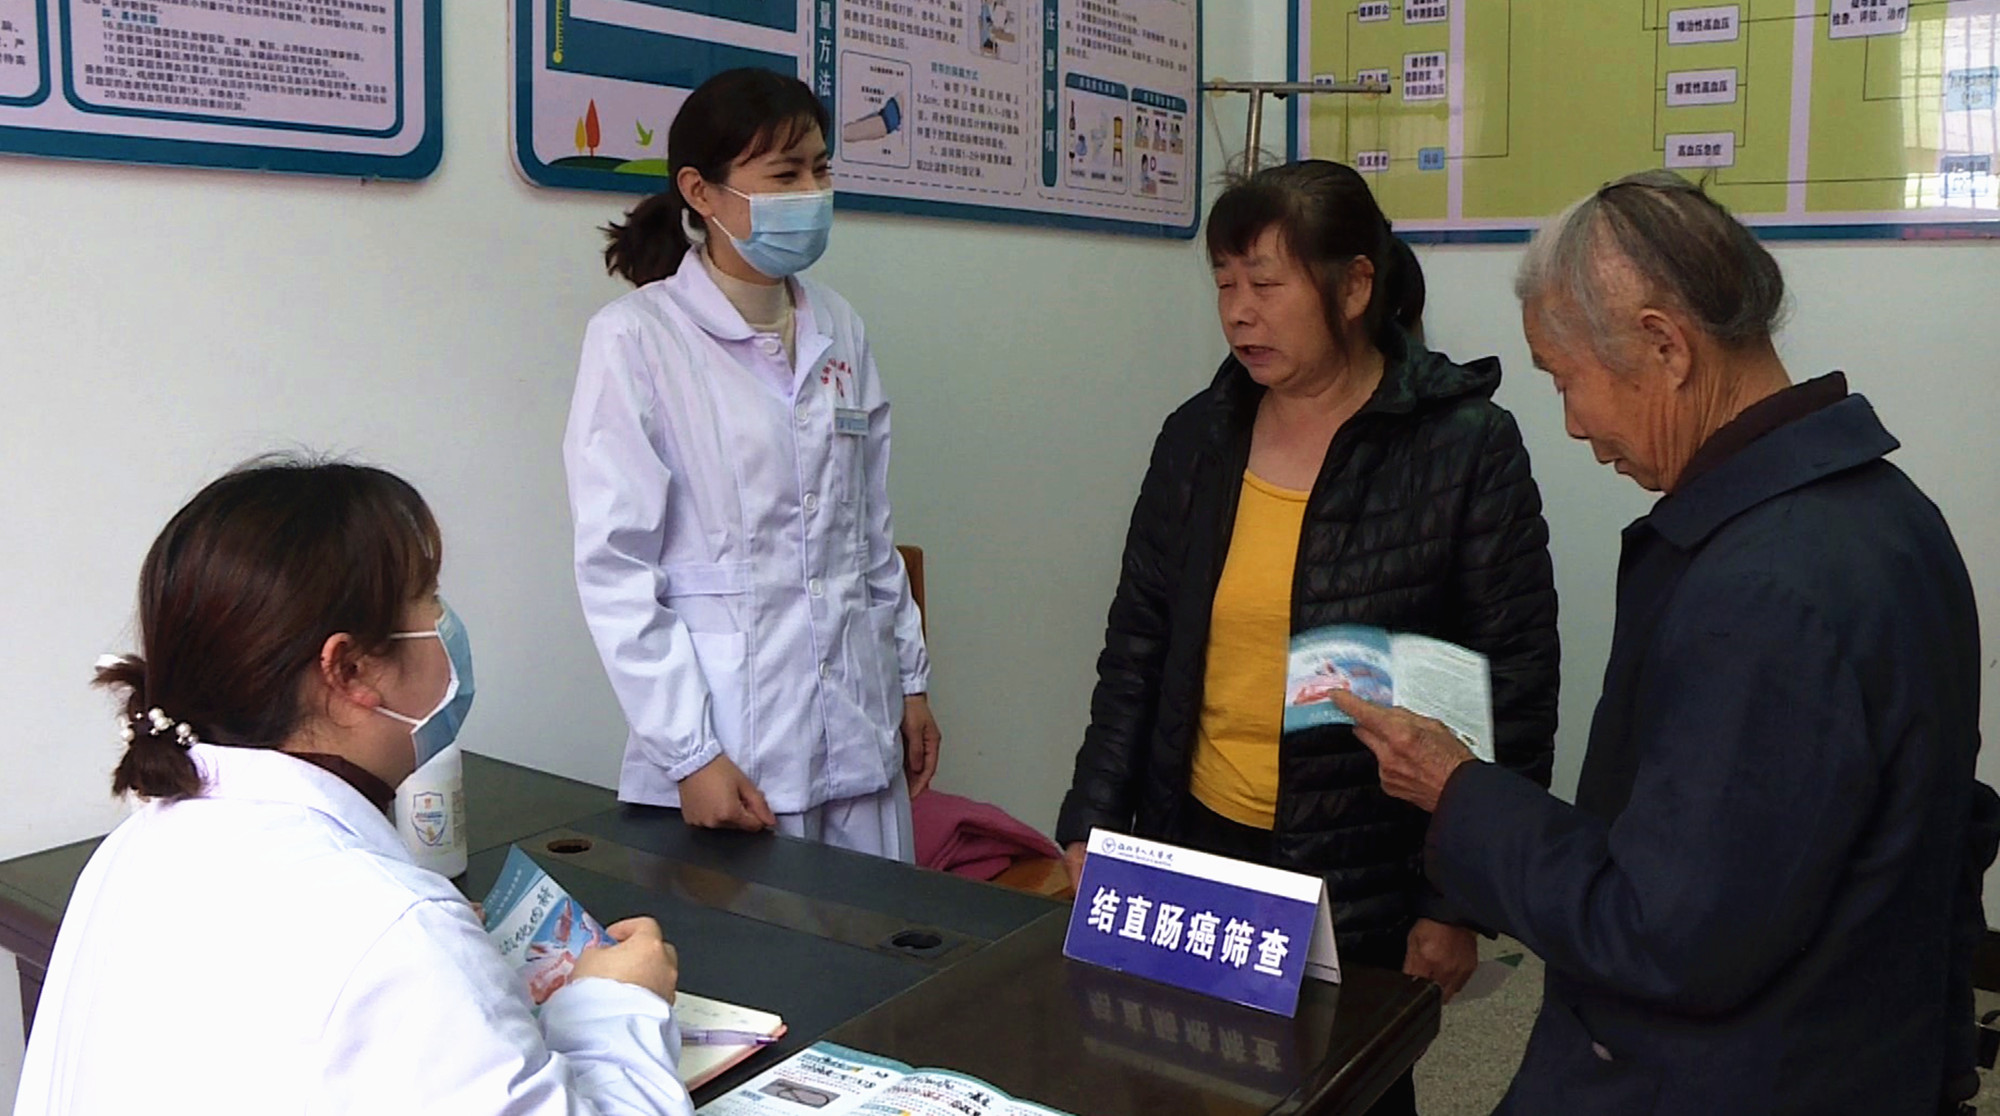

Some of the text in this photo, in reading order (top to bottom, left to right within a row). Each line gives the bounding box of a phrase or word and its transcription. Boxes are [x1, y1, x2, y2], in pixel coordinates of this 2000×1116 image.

[1087, 886, 1290, 977] 结直肠癌筛查
